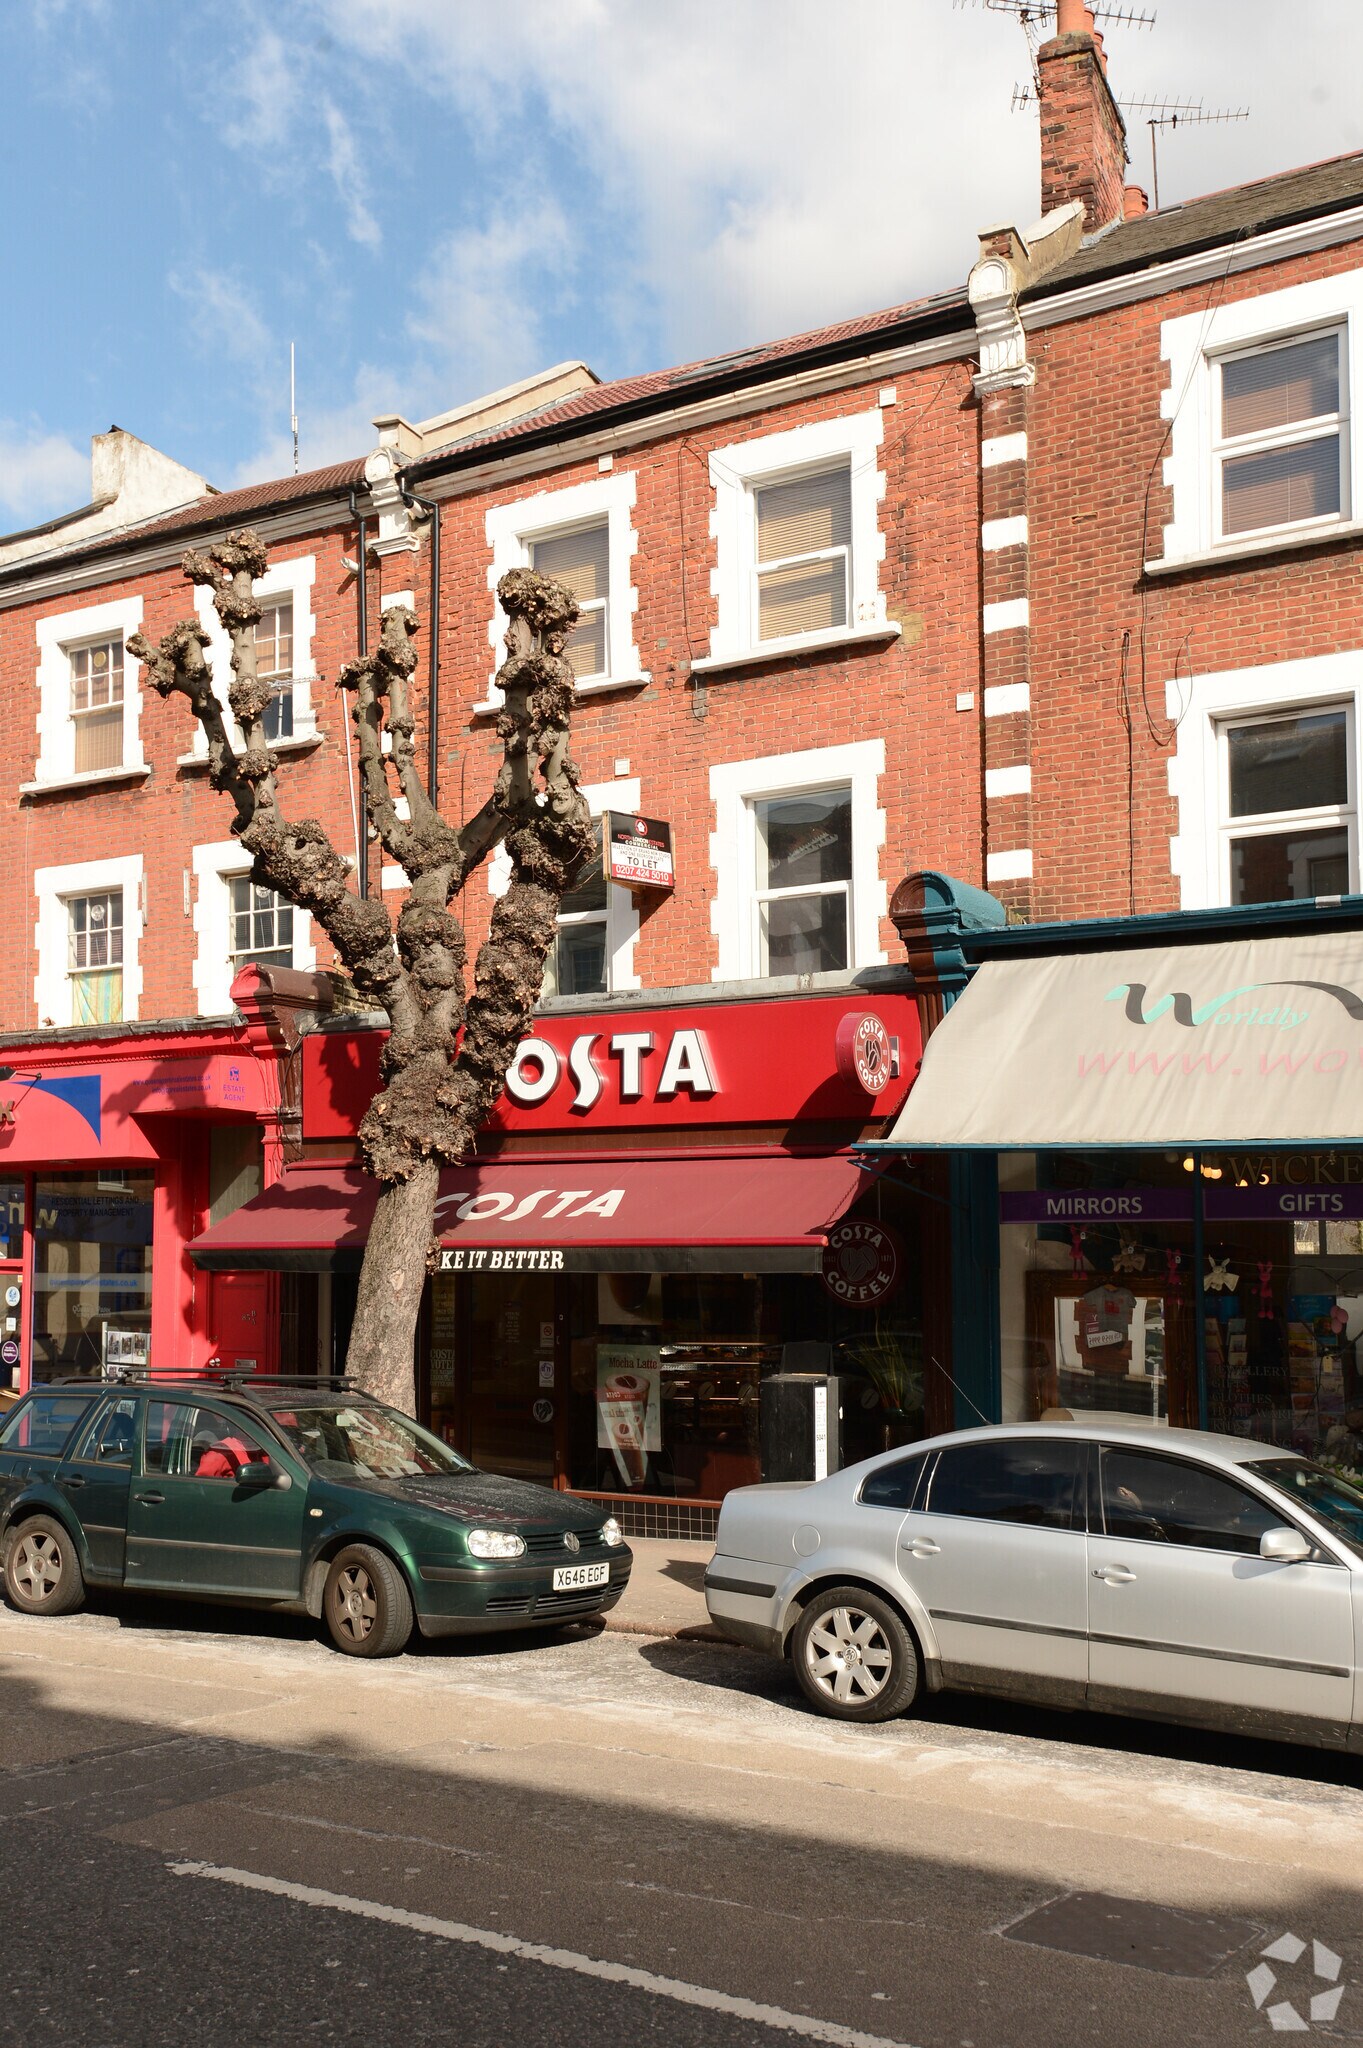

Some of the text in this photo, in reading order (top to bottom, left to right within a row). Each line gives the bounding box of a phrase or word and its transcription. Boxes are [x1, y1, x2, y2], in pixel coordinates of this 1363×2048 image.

[627, 856, 658, 869] TO LET
[616, 865, 669, 881] 0207 424 5010
[1103, 979, 1310, 1032] Worldly
[859, 1020, 884, 1042] COSTA
[858, 1059, 888, 1087] COFFEE
[223, 1084, 246, 1093] ESTATE
[224, 1093, 246, 1102] AGENT
[51, 1196, 139, 1206] RESIDENTIAL LETTINGS AND
[1046, 1196, 1143, 1215] MIRRORS
[1279, 1193, 1344, 1213] GIFTS
[55, 1207, 134, 1217] PROPERTY MANAGEMENT
[830, 1225, 884, 1249] COSTA
[467, 1250, 488, 1269] IT
[488, 1250, 565, 1270] BETTER
[827, 1271, 890, 1299] COFFEE
[608, 1357, 658, 1369] Mocha Latte
[1212, 1392, 1273, 1404] CLOTHES
[557, 1564, 607, 1587] X646 EGF
